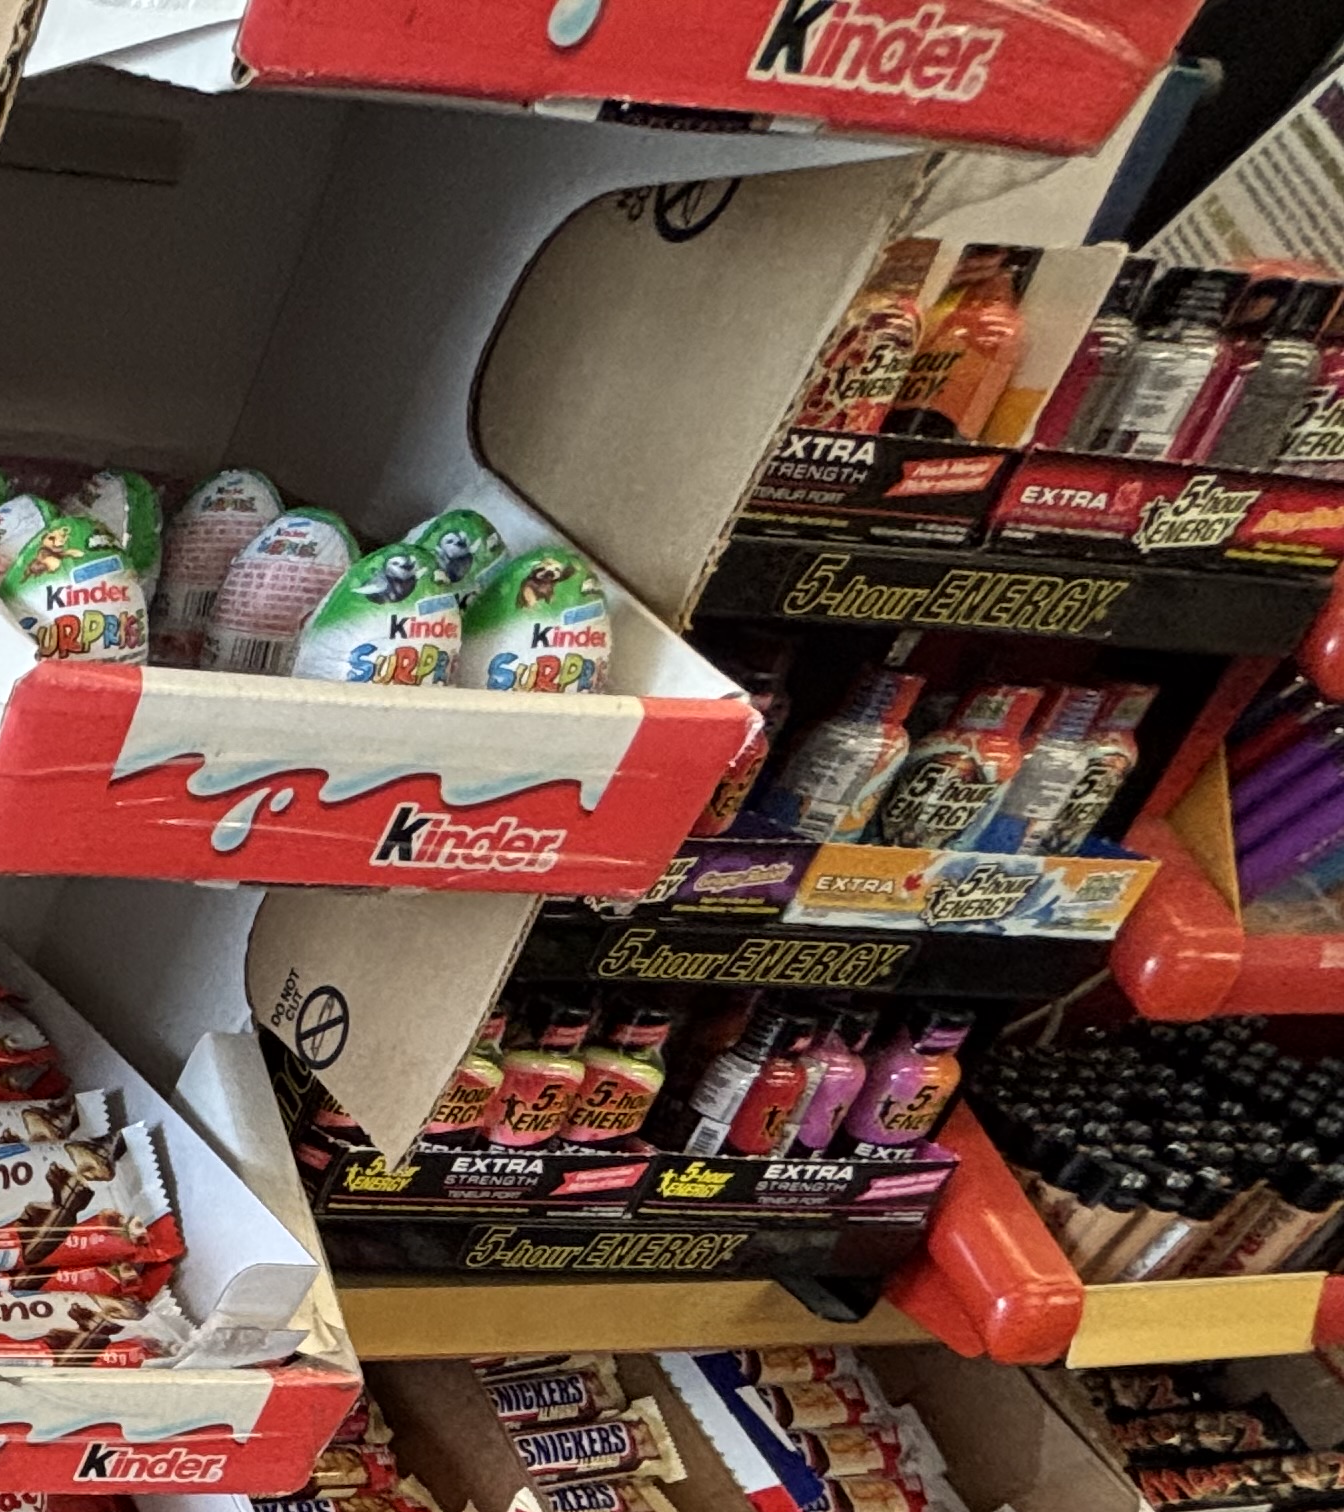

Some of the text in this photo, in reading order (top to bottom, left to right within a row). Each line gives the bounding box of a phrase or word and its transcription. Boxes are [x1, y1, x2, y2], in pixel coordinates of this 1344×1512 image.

[752, 0, 1001, 100] Kinder
[778, 434, 875, 466] XTRA
[766, 460, 869, 483] TRENGTH
[1019, 485, 1109, 511] EXTRA
[1150, 512, 1240, 545] ENERGY
[46, 580, 130, 611] Kinder
[783, 553, 1129, 633] 5-hour ENERGY
[372, 803, 565, 873] Kinder
[815, 874, 895, 894] EXTRA
[936, 890, 1017, 919] ENERGY
[598, 928, 912, 987] 5-hour ENERGY
[270, 967, 300, 1028] DO NOT
[285, 989, 304, 1022] CUT
[443, 1174, 539, 1187] STRENGTH
[451, 1157, 545, 1175] EXTRA
[763, 1163, 855, 1182] EXTRA
[754, 1180, 849, 1193] STRENGTH
[465, 1226, 749, 1270] 5-hour ENERGY
[518, 1424, 628, 1467] SNICKERS
[72, 1441, 226, 1485] Kinder
